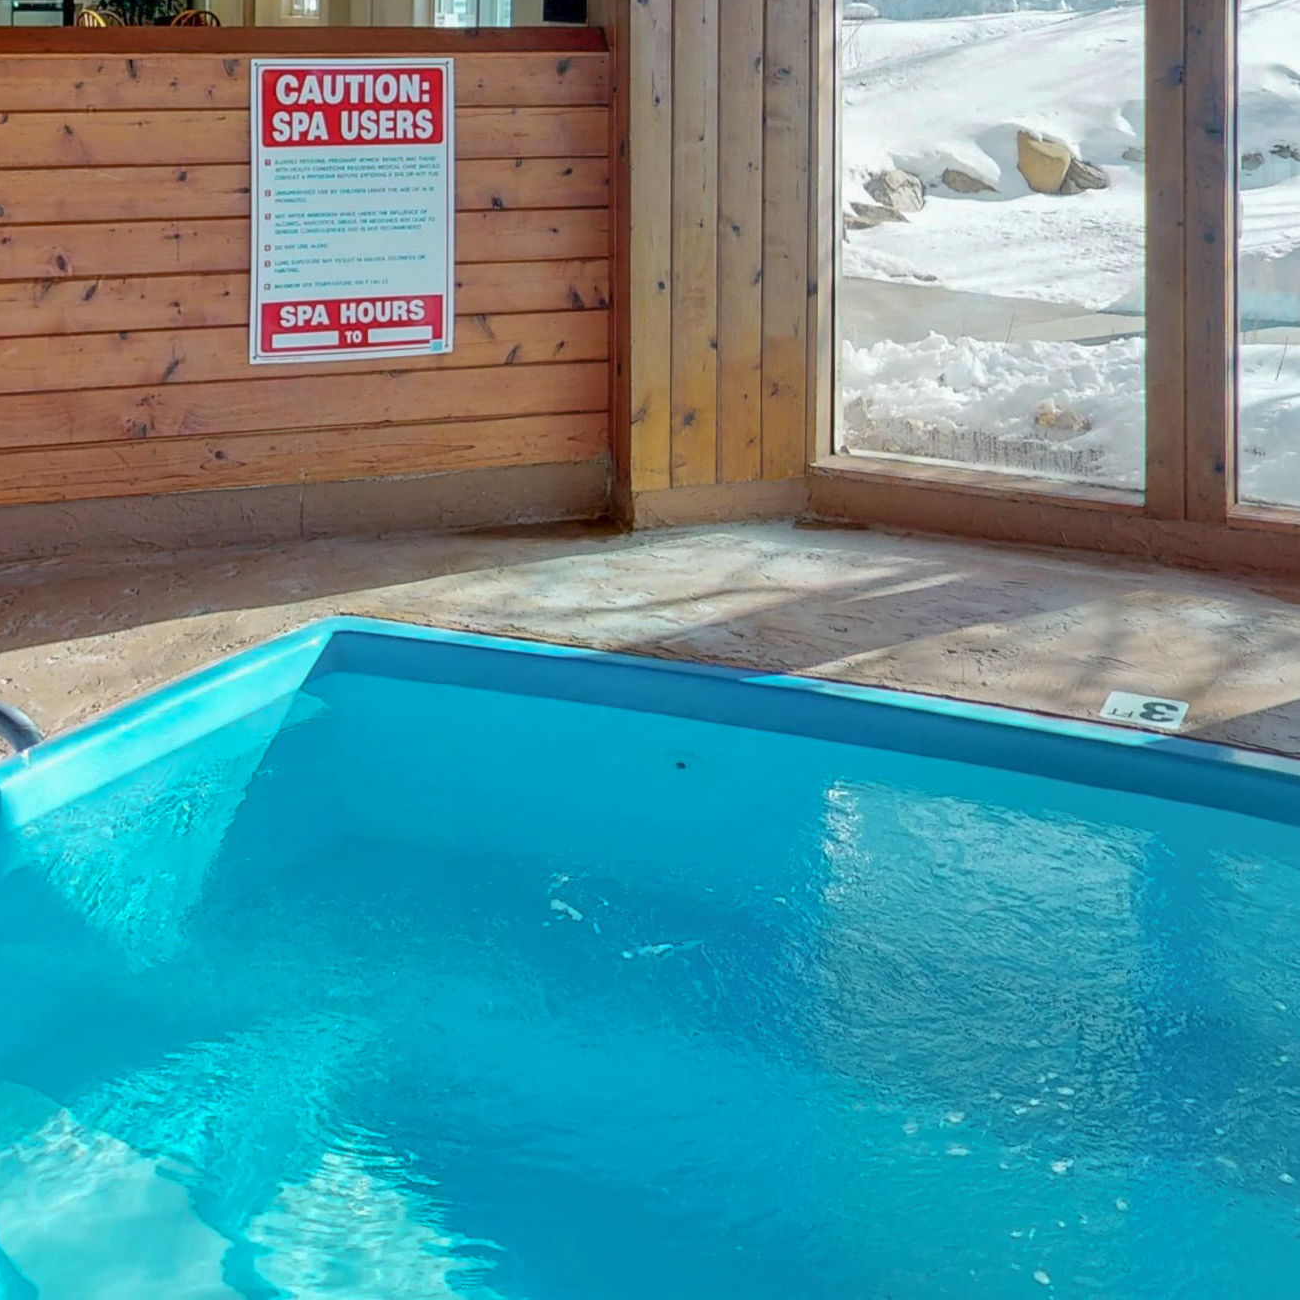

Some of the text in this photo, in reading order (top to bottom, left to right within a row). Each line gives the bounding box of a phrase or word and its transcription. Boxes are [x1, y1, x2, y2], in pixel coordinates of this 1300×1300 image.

[275, 73, 430, 105] CAUTION:
[272, 108, 434, 142] SPA USERS
[280, 299, 425, 328] SPA HOURS
[345, 330, 362, 344] TO
[1139, 701, 1179, 722] 3
